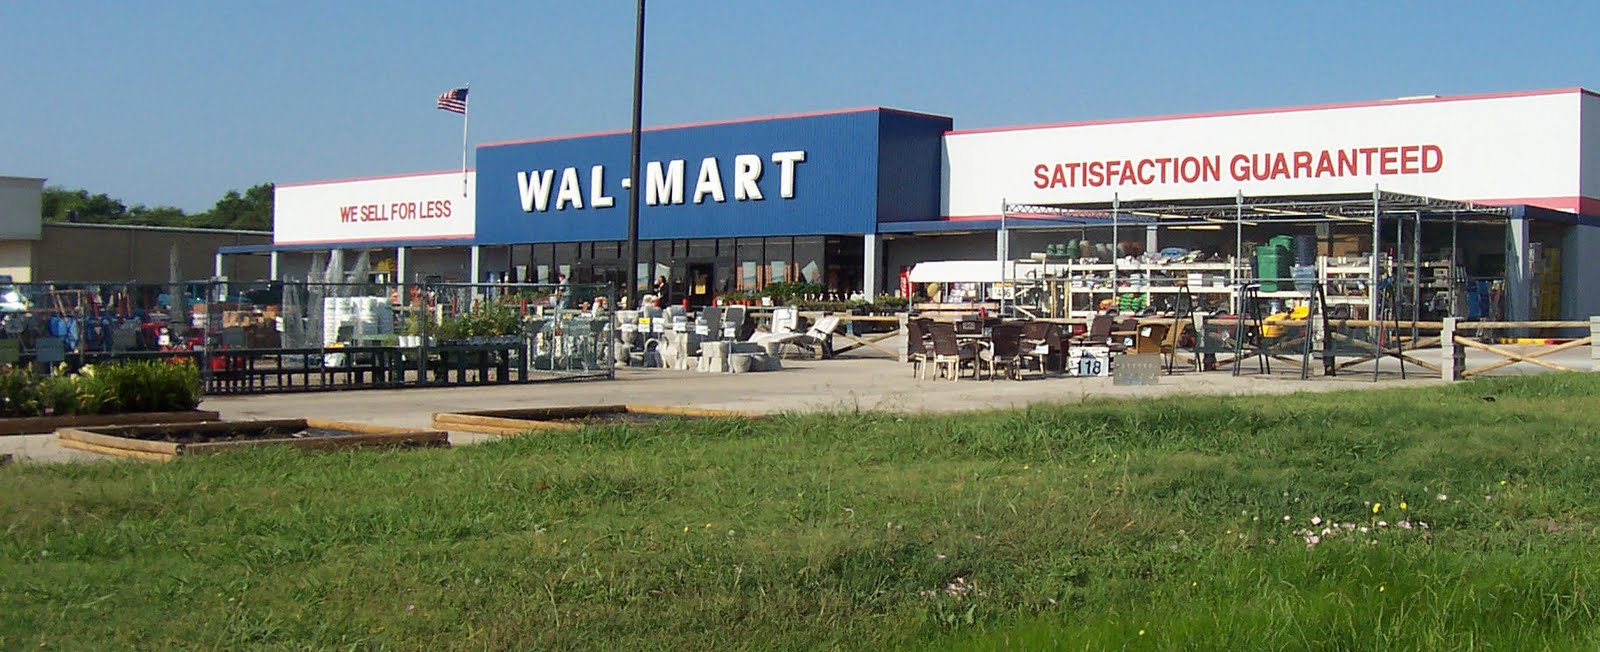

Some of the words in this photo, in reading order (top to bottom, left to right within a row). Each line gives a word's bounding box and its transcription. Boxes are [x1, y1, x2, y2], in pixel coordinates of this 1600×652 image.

[1034, 154, 1220, 189] SATISFACTION
[1229, 144, 1443, 181] GUARANTEED
[340, 206, 357, 223] WE
[360, 204, 388, 222] SELL
[391, 202, 416, 220] FOR
[419, 200, 451, 218] LESS
